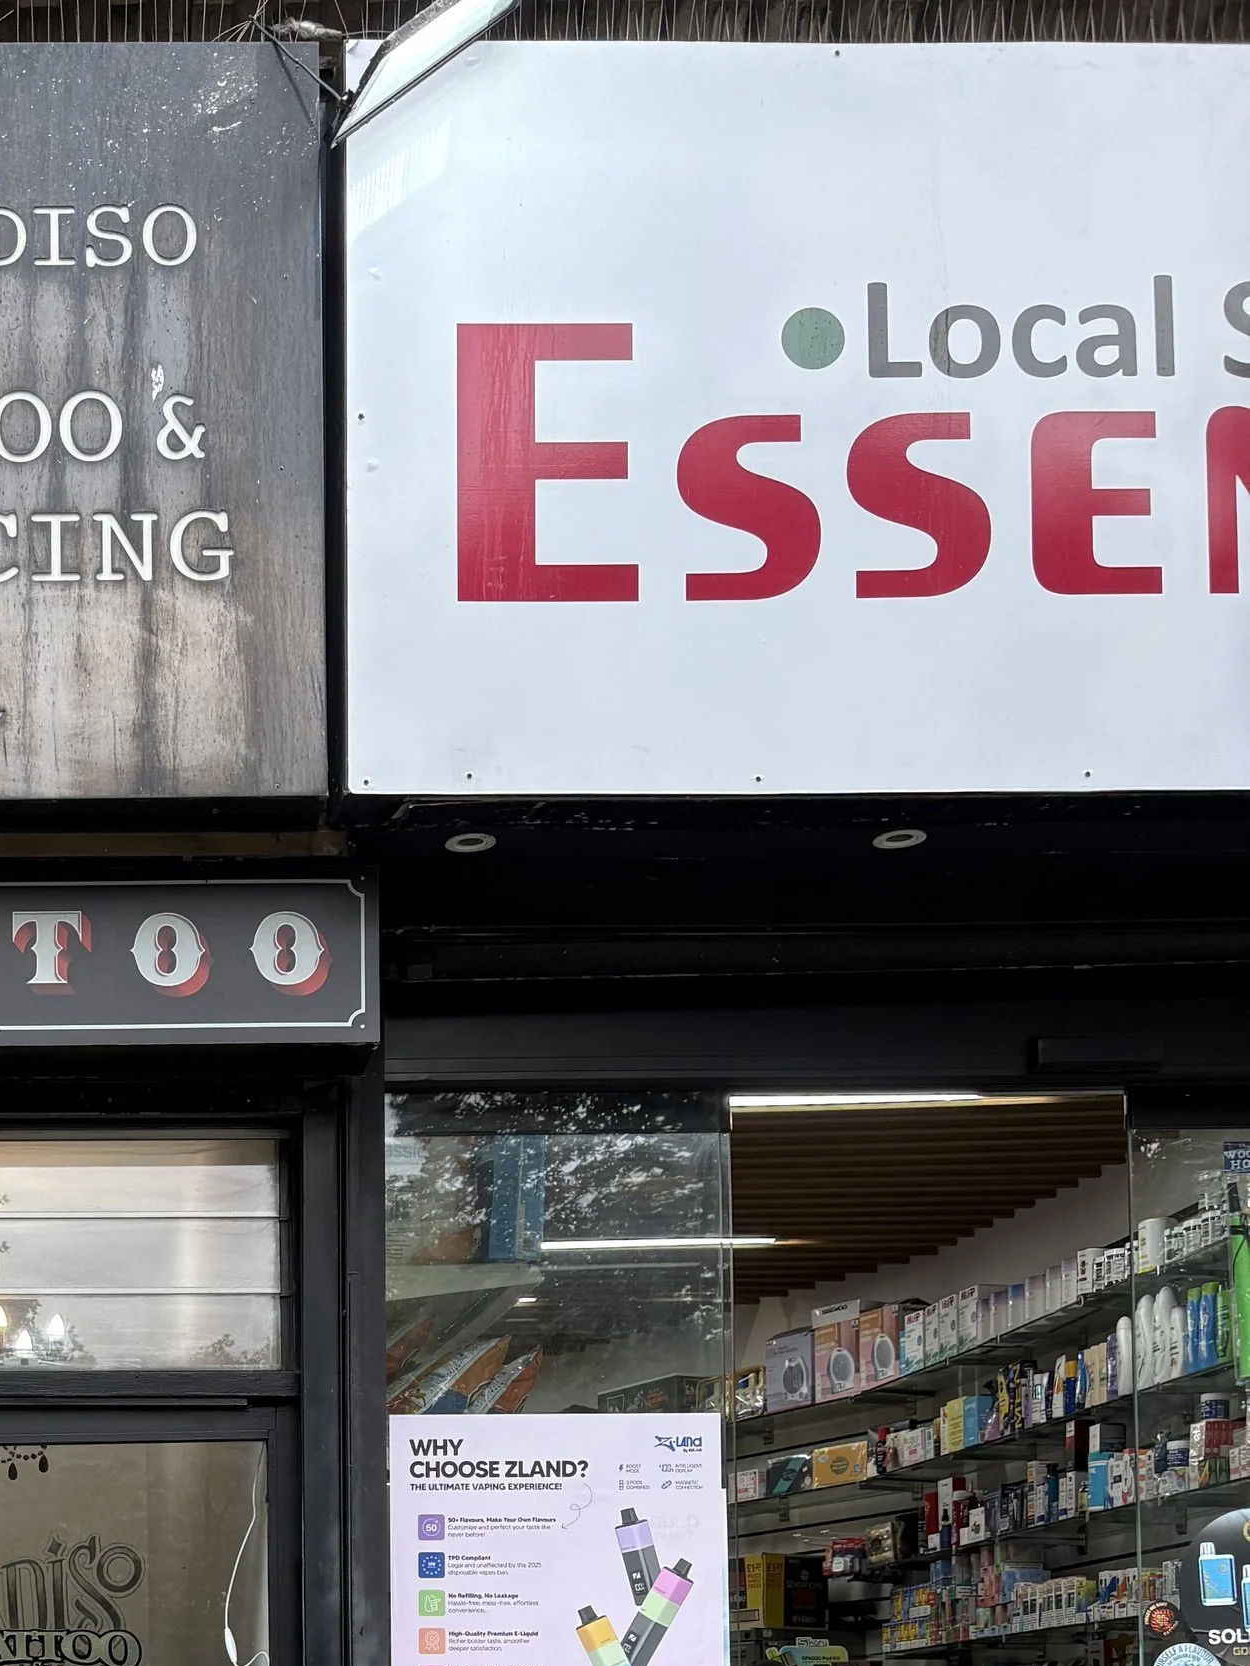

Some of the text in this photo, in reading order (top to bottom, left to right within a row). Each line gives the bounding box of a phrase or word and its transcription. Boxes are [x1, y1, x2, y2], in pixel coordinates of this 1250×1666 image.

[866, 274, 1176, 379] Local
[156, 394, 207, 462] &
[409, 1438, 464, 1457] WHY
[409, 1460, 589, 1479] CHOOSE ZLAND?
[410, 1483, 563, 1491] THE ULTIMATE VAPING EXPERIENCE!
[1233, 1647, 1250, 1656] GO
